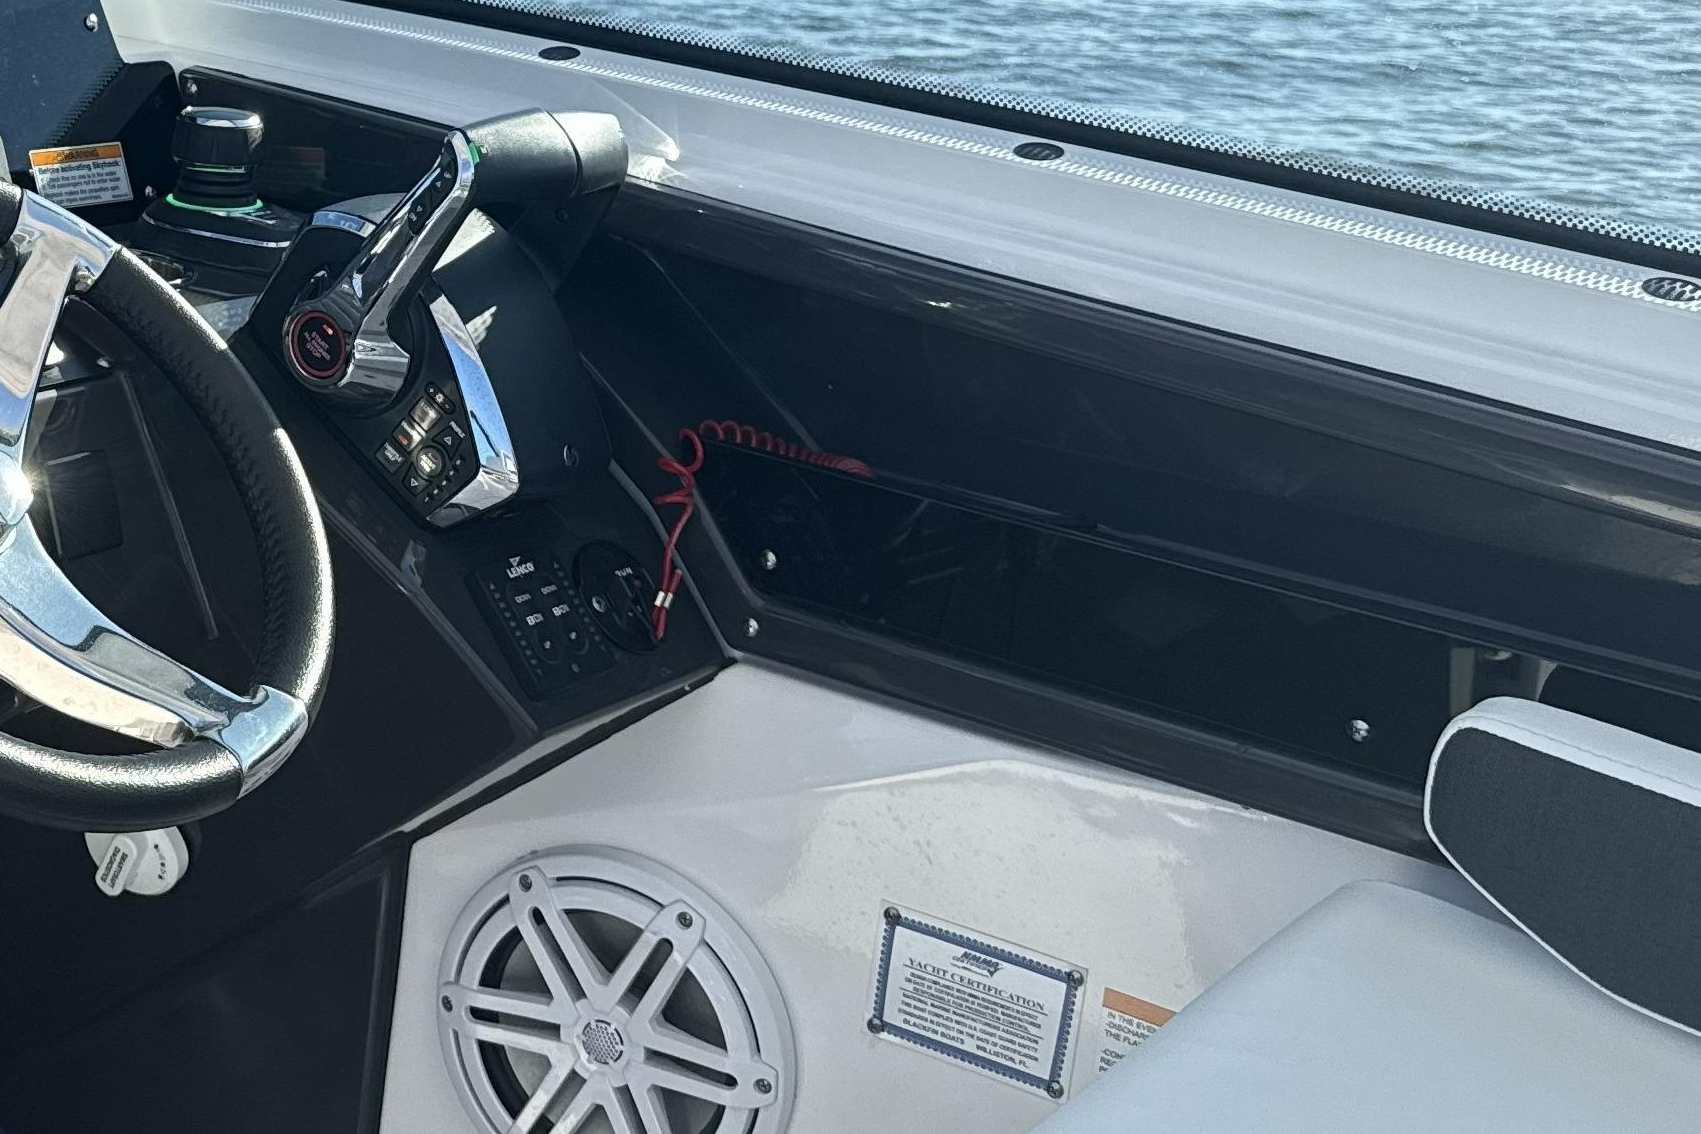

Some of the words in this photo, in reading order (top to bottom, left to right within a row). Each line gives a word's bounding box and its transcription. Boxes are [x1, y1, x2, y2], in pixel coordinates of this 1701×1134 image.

[506, 562, 535, 579] LENCO
[615, 567, 634, 577] RUN
[908, 957, 947, 978] YACHT
[951, 972, 1045, 1012] CERTIFICATION
[1107, 1011, 1115, 1019] IN
[1119, 1014, 1135, 1026] THE
[1104, 1029, 1121, 1041] THE
[1123, 1036, 1142, 1046] FLA
